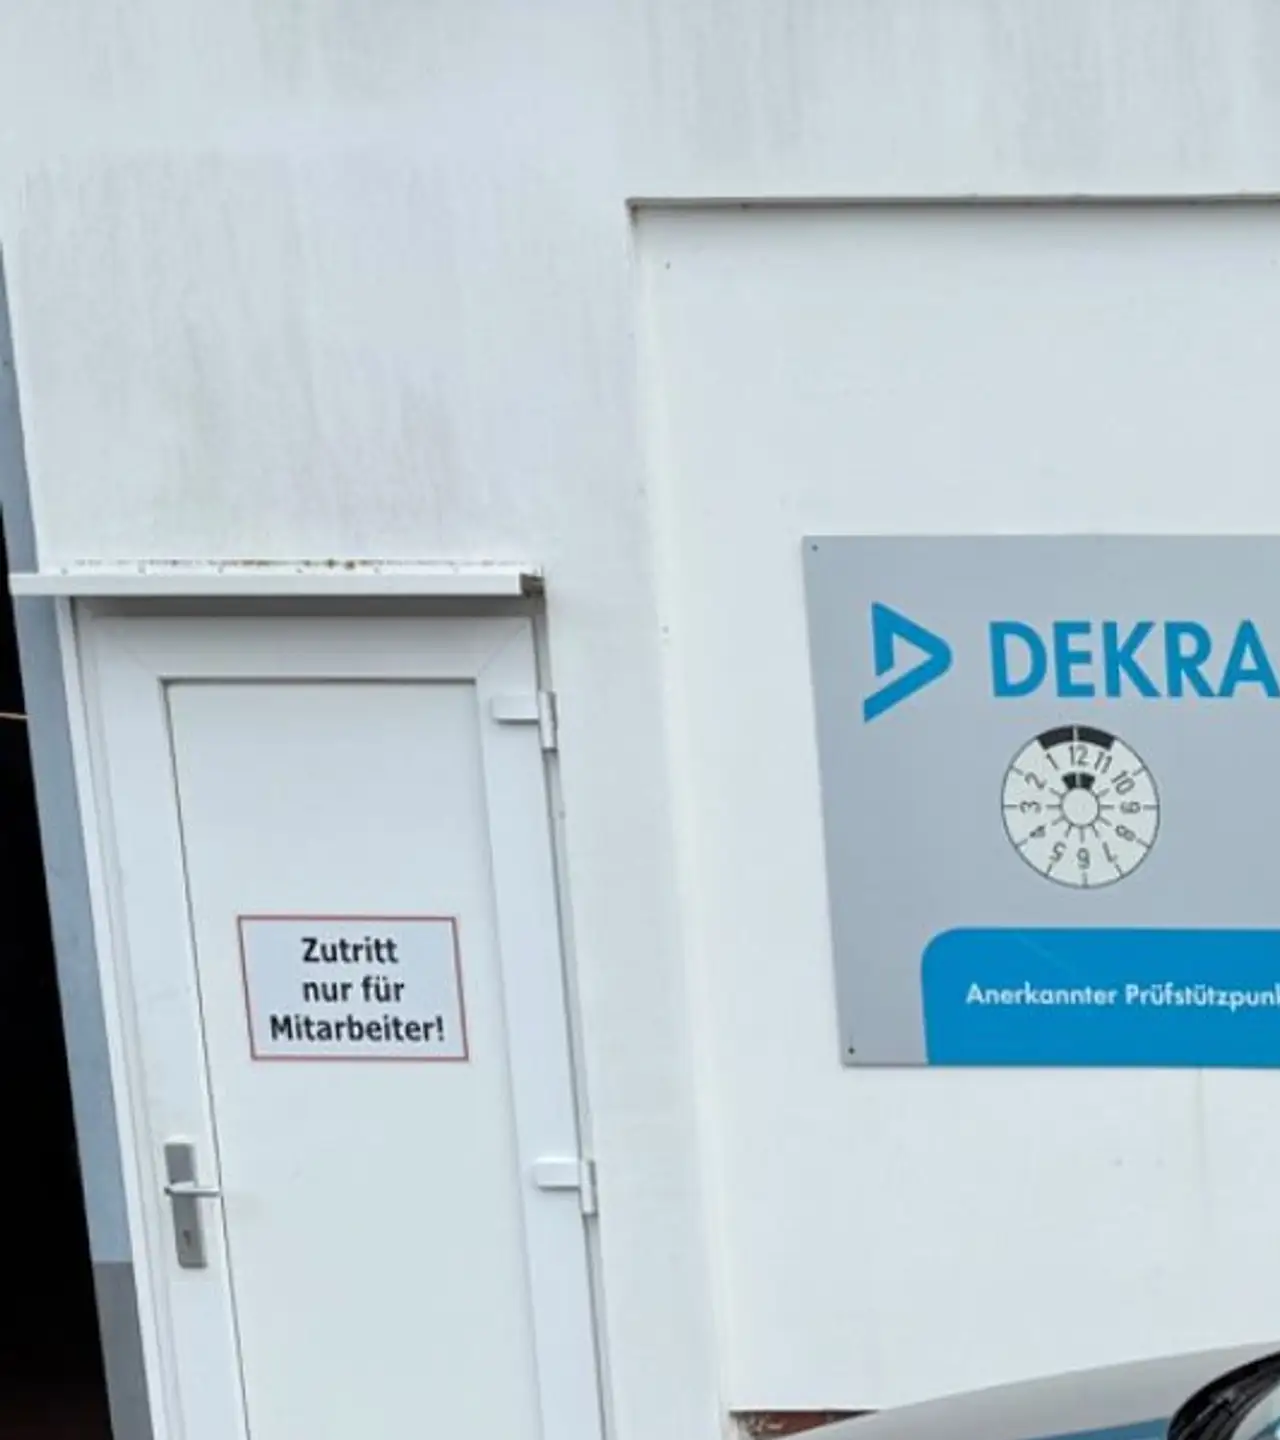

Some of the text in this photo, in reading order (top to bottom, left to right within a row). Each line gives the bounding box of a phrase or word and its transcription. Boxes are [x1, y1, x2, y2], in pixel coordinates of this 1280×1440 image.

[1046, 752, 1059, 770] 1
[1069, 745, 1089, 766] 12
[1094, 752, 1113, 773] 11
[1025, 772, 1046, 789] 2
[1111, 771, 1135, 795] 10
[1020, 801, 1041, 814] 3
[1115, 824, 1136, 841] 8
[1050, 841, 1067, 862] 5
[1077, 847, 1090, 869] 6
[301, 936, 399, 964] Zutritt
[302, 975, 405, 1002] nur für
[966, 983, 1117, 1006] Anerkannter
[269, 1014, 445, 1041] Mitarbeiter!
